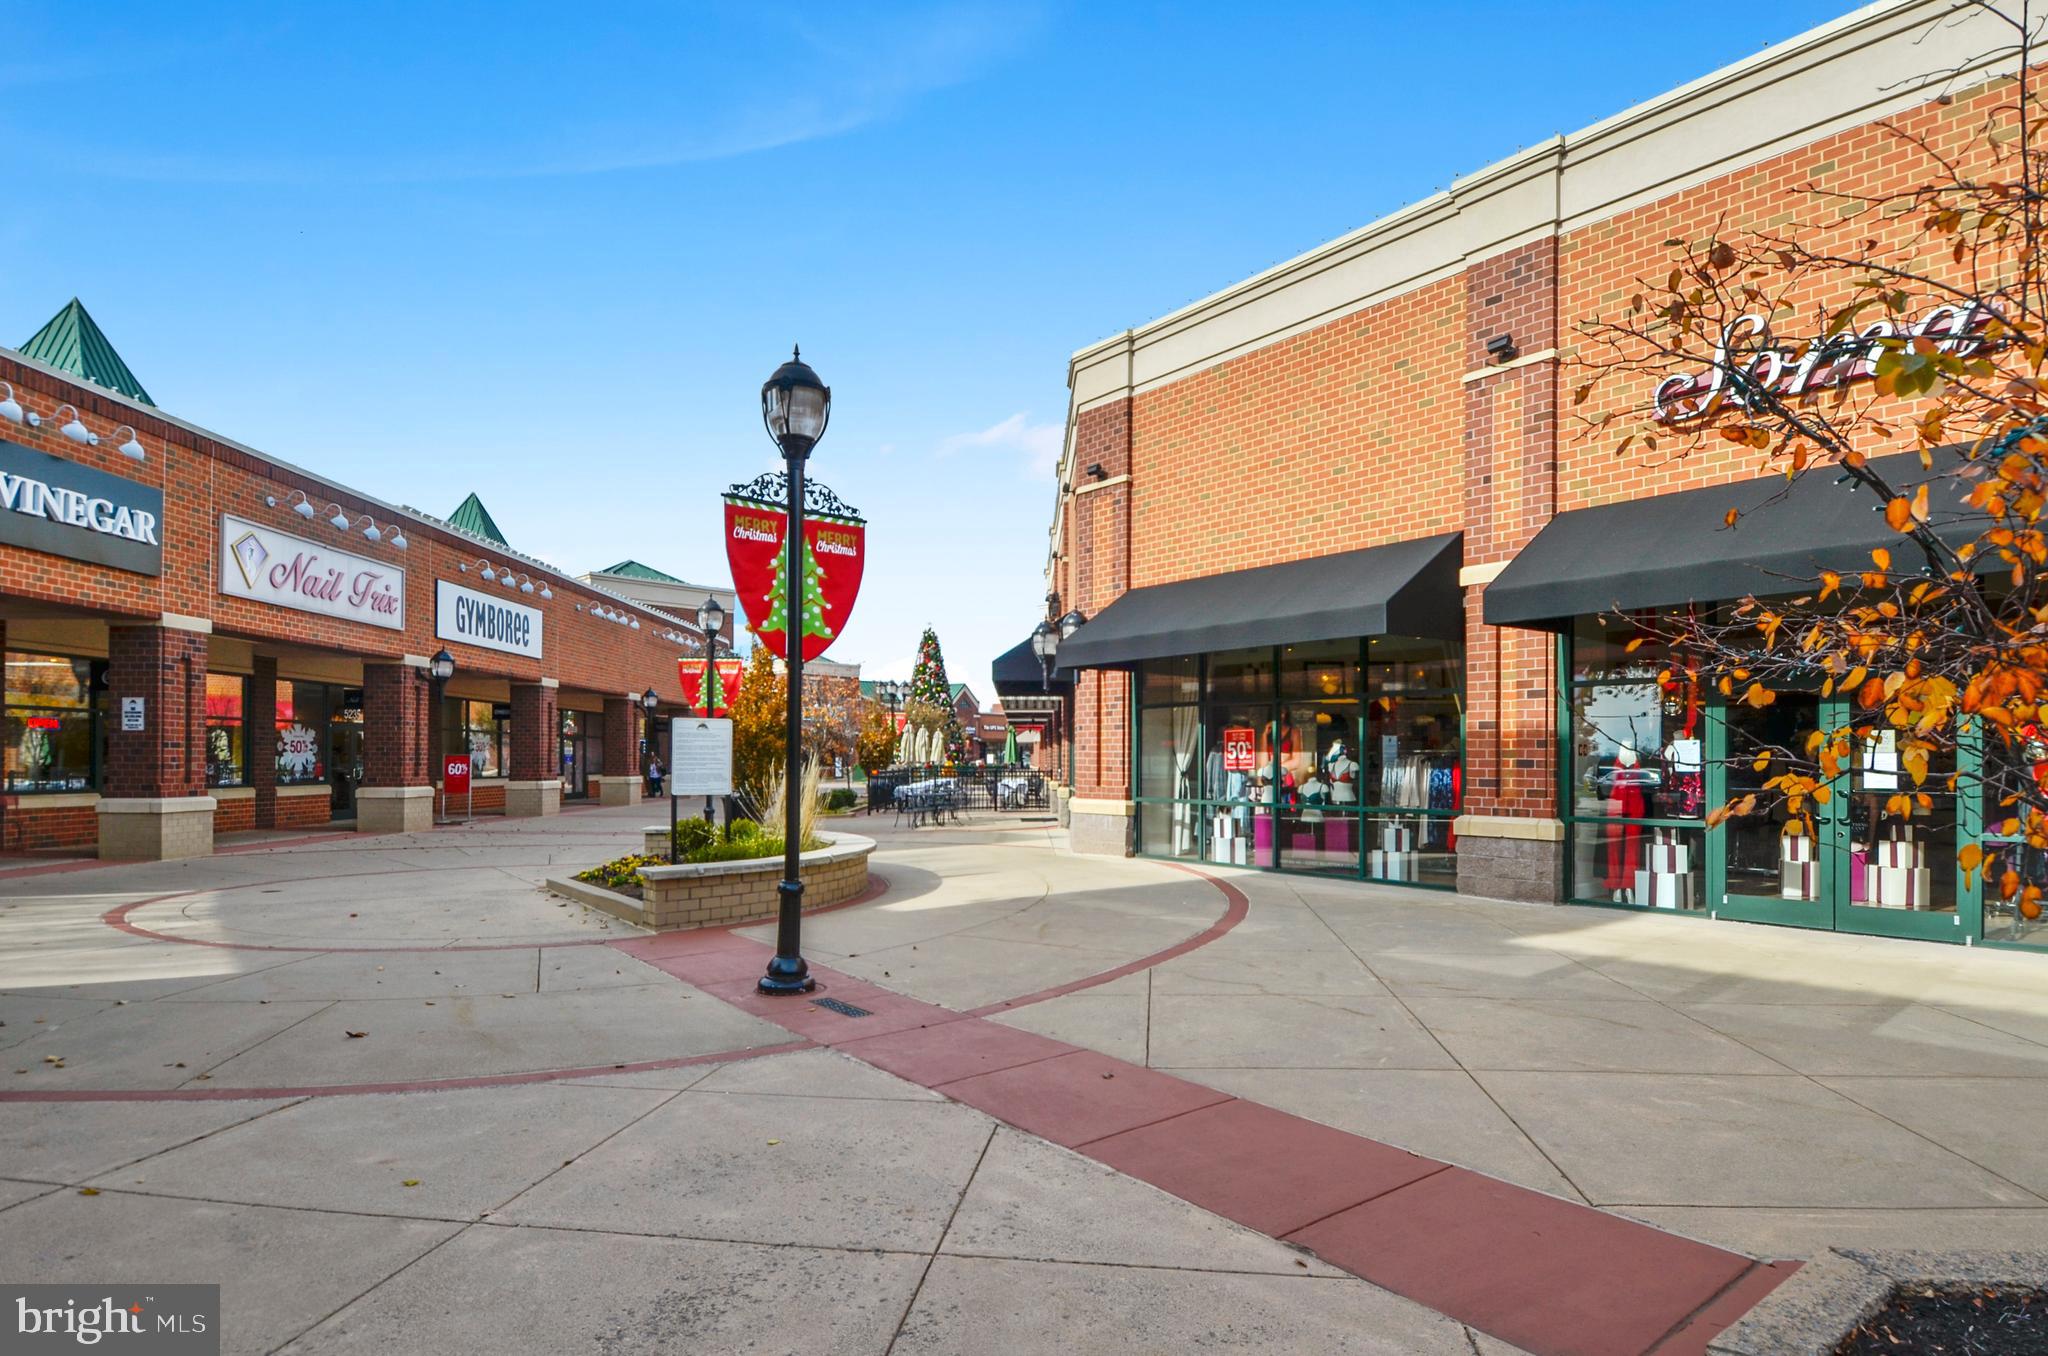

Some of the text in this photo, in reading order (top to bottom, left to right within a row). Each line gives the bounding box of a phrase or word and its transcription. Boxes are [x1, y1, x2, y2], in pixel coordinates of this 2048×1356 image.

[0, 470, 158, 546] VINEGAR
[734, 515, 777, 533] MERRY
[733, 526, 777, 543] Christmas
[817, 529, 857, 547] MERRY
[816, 540, 857, 557] Christmas
[269, 552, 399, 615] Nail Trix
